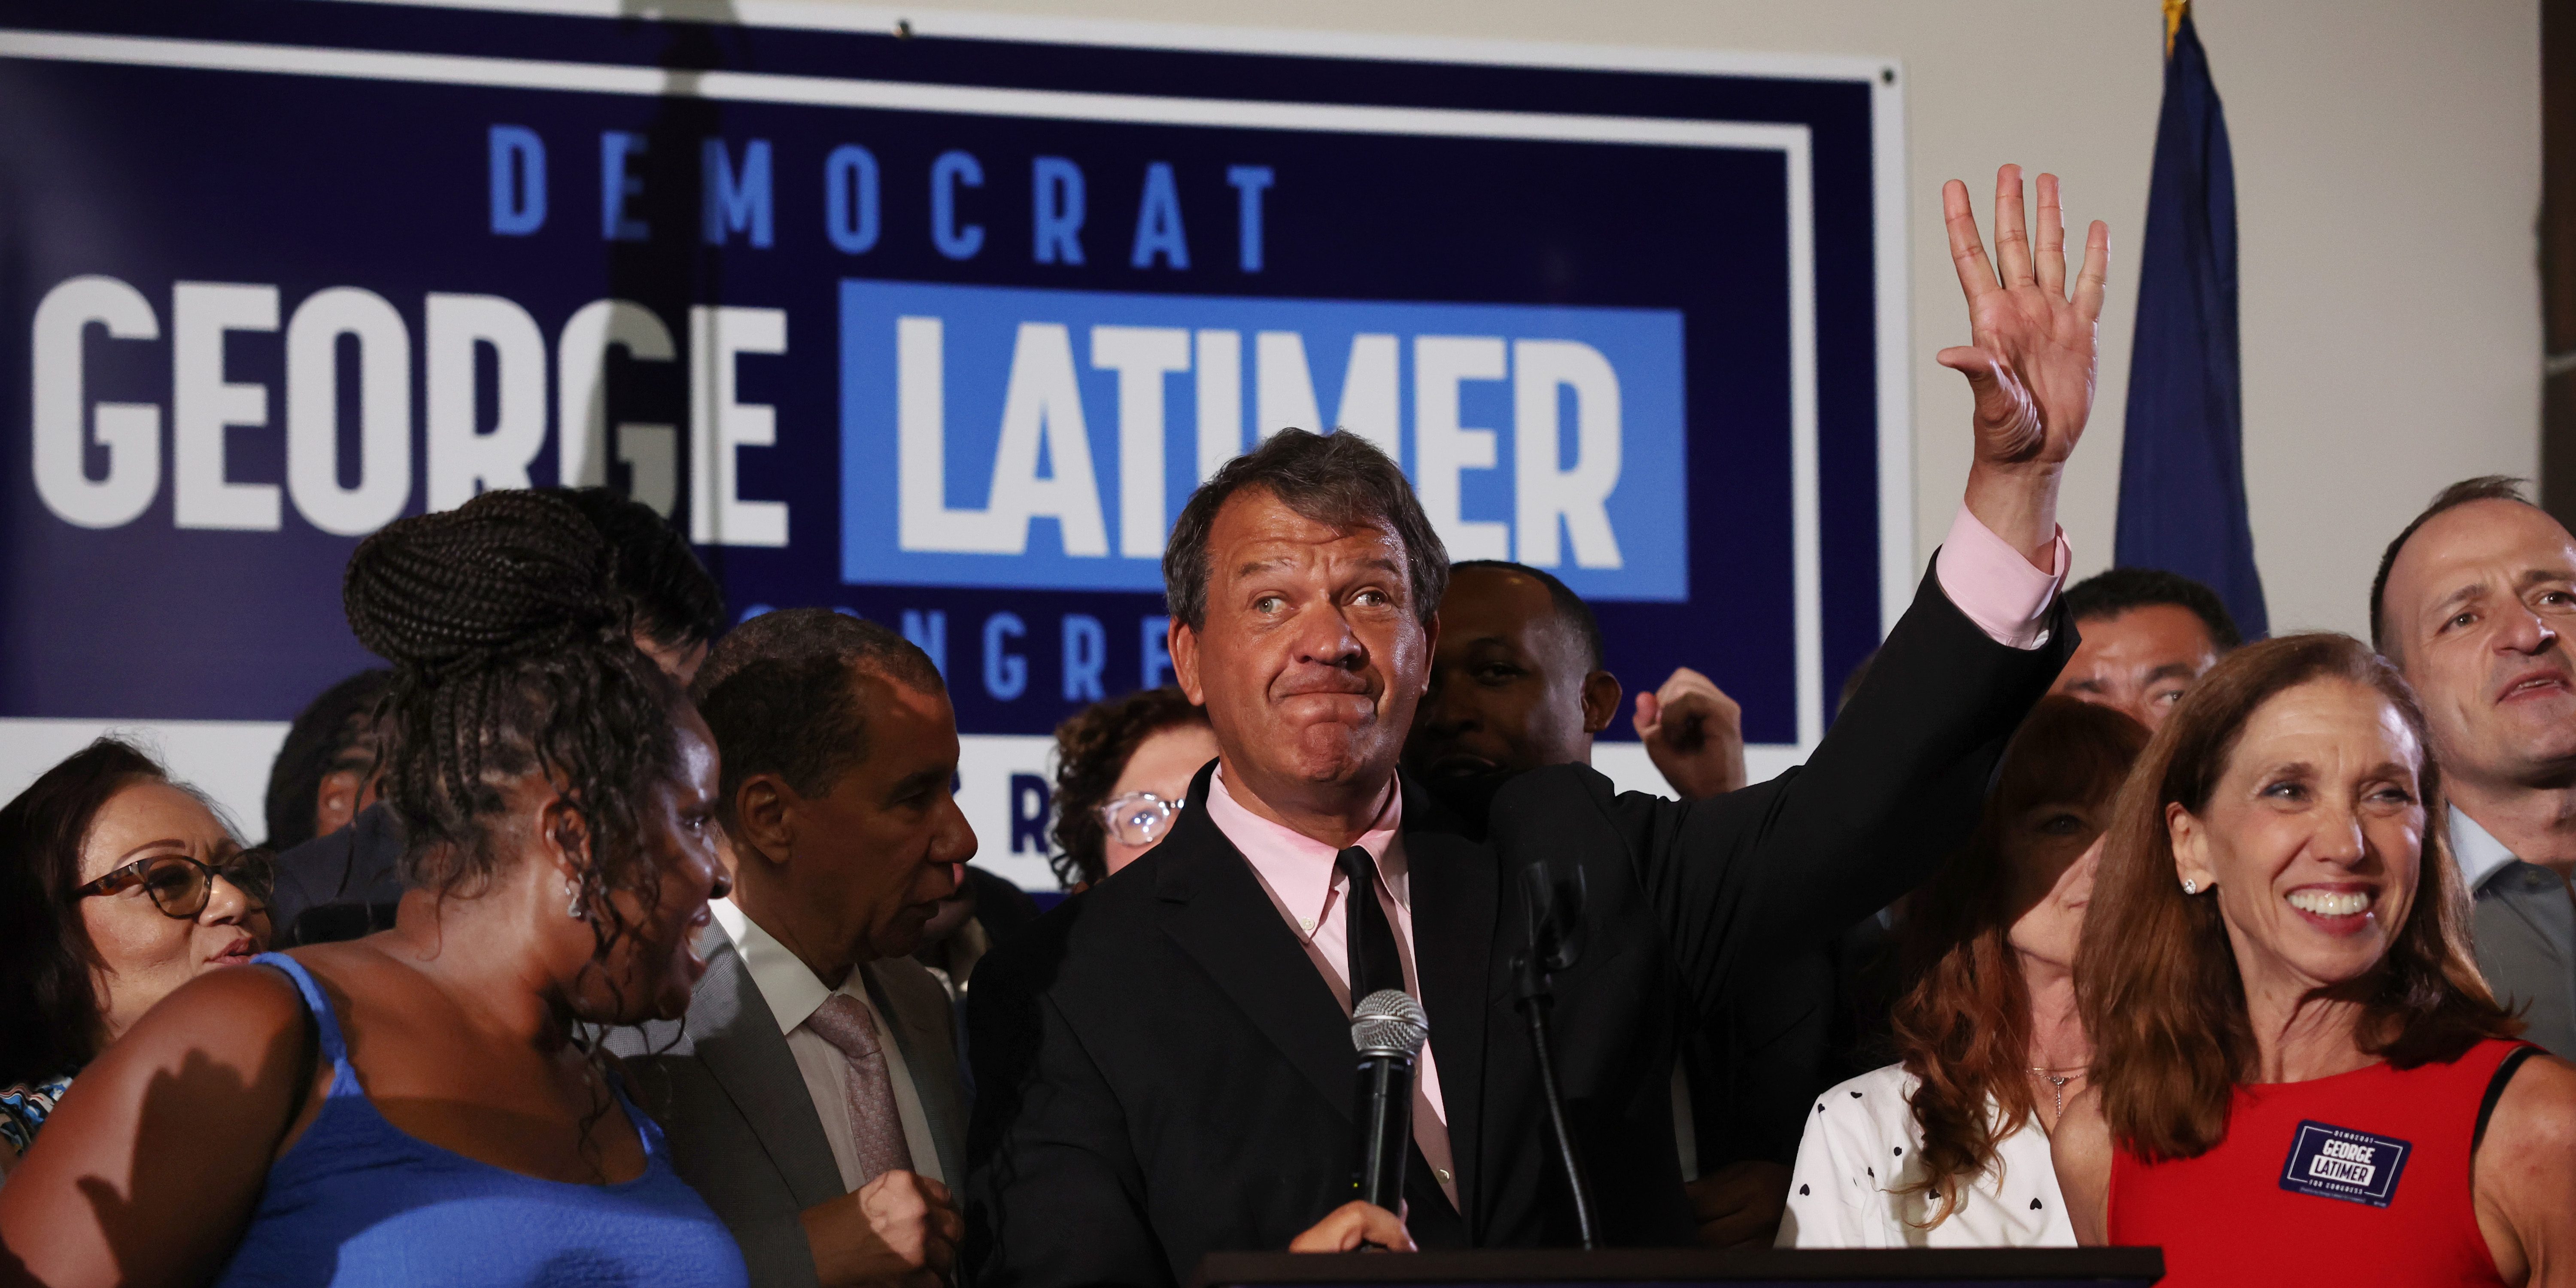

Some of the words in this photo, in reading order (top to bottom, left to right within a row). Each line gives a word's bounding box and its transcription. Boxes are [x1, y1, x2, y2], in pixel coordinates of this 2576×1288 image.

[490, 125, 1274, 272] DEMOCRAT
[33, 274, 788, 545] GEORGE
[897, 317, 1623, 569] LATIMER
[738, 604, 1174, 702] NGRE
[2334, 1130, 2374, 1143] DEMOCRAT
[2322, 1139, 2376, 1163] GEORGE
[2315, 1157, 2368, 1182] LATIMER
[2326, 1182, 2363, 1194] CONGRESS
